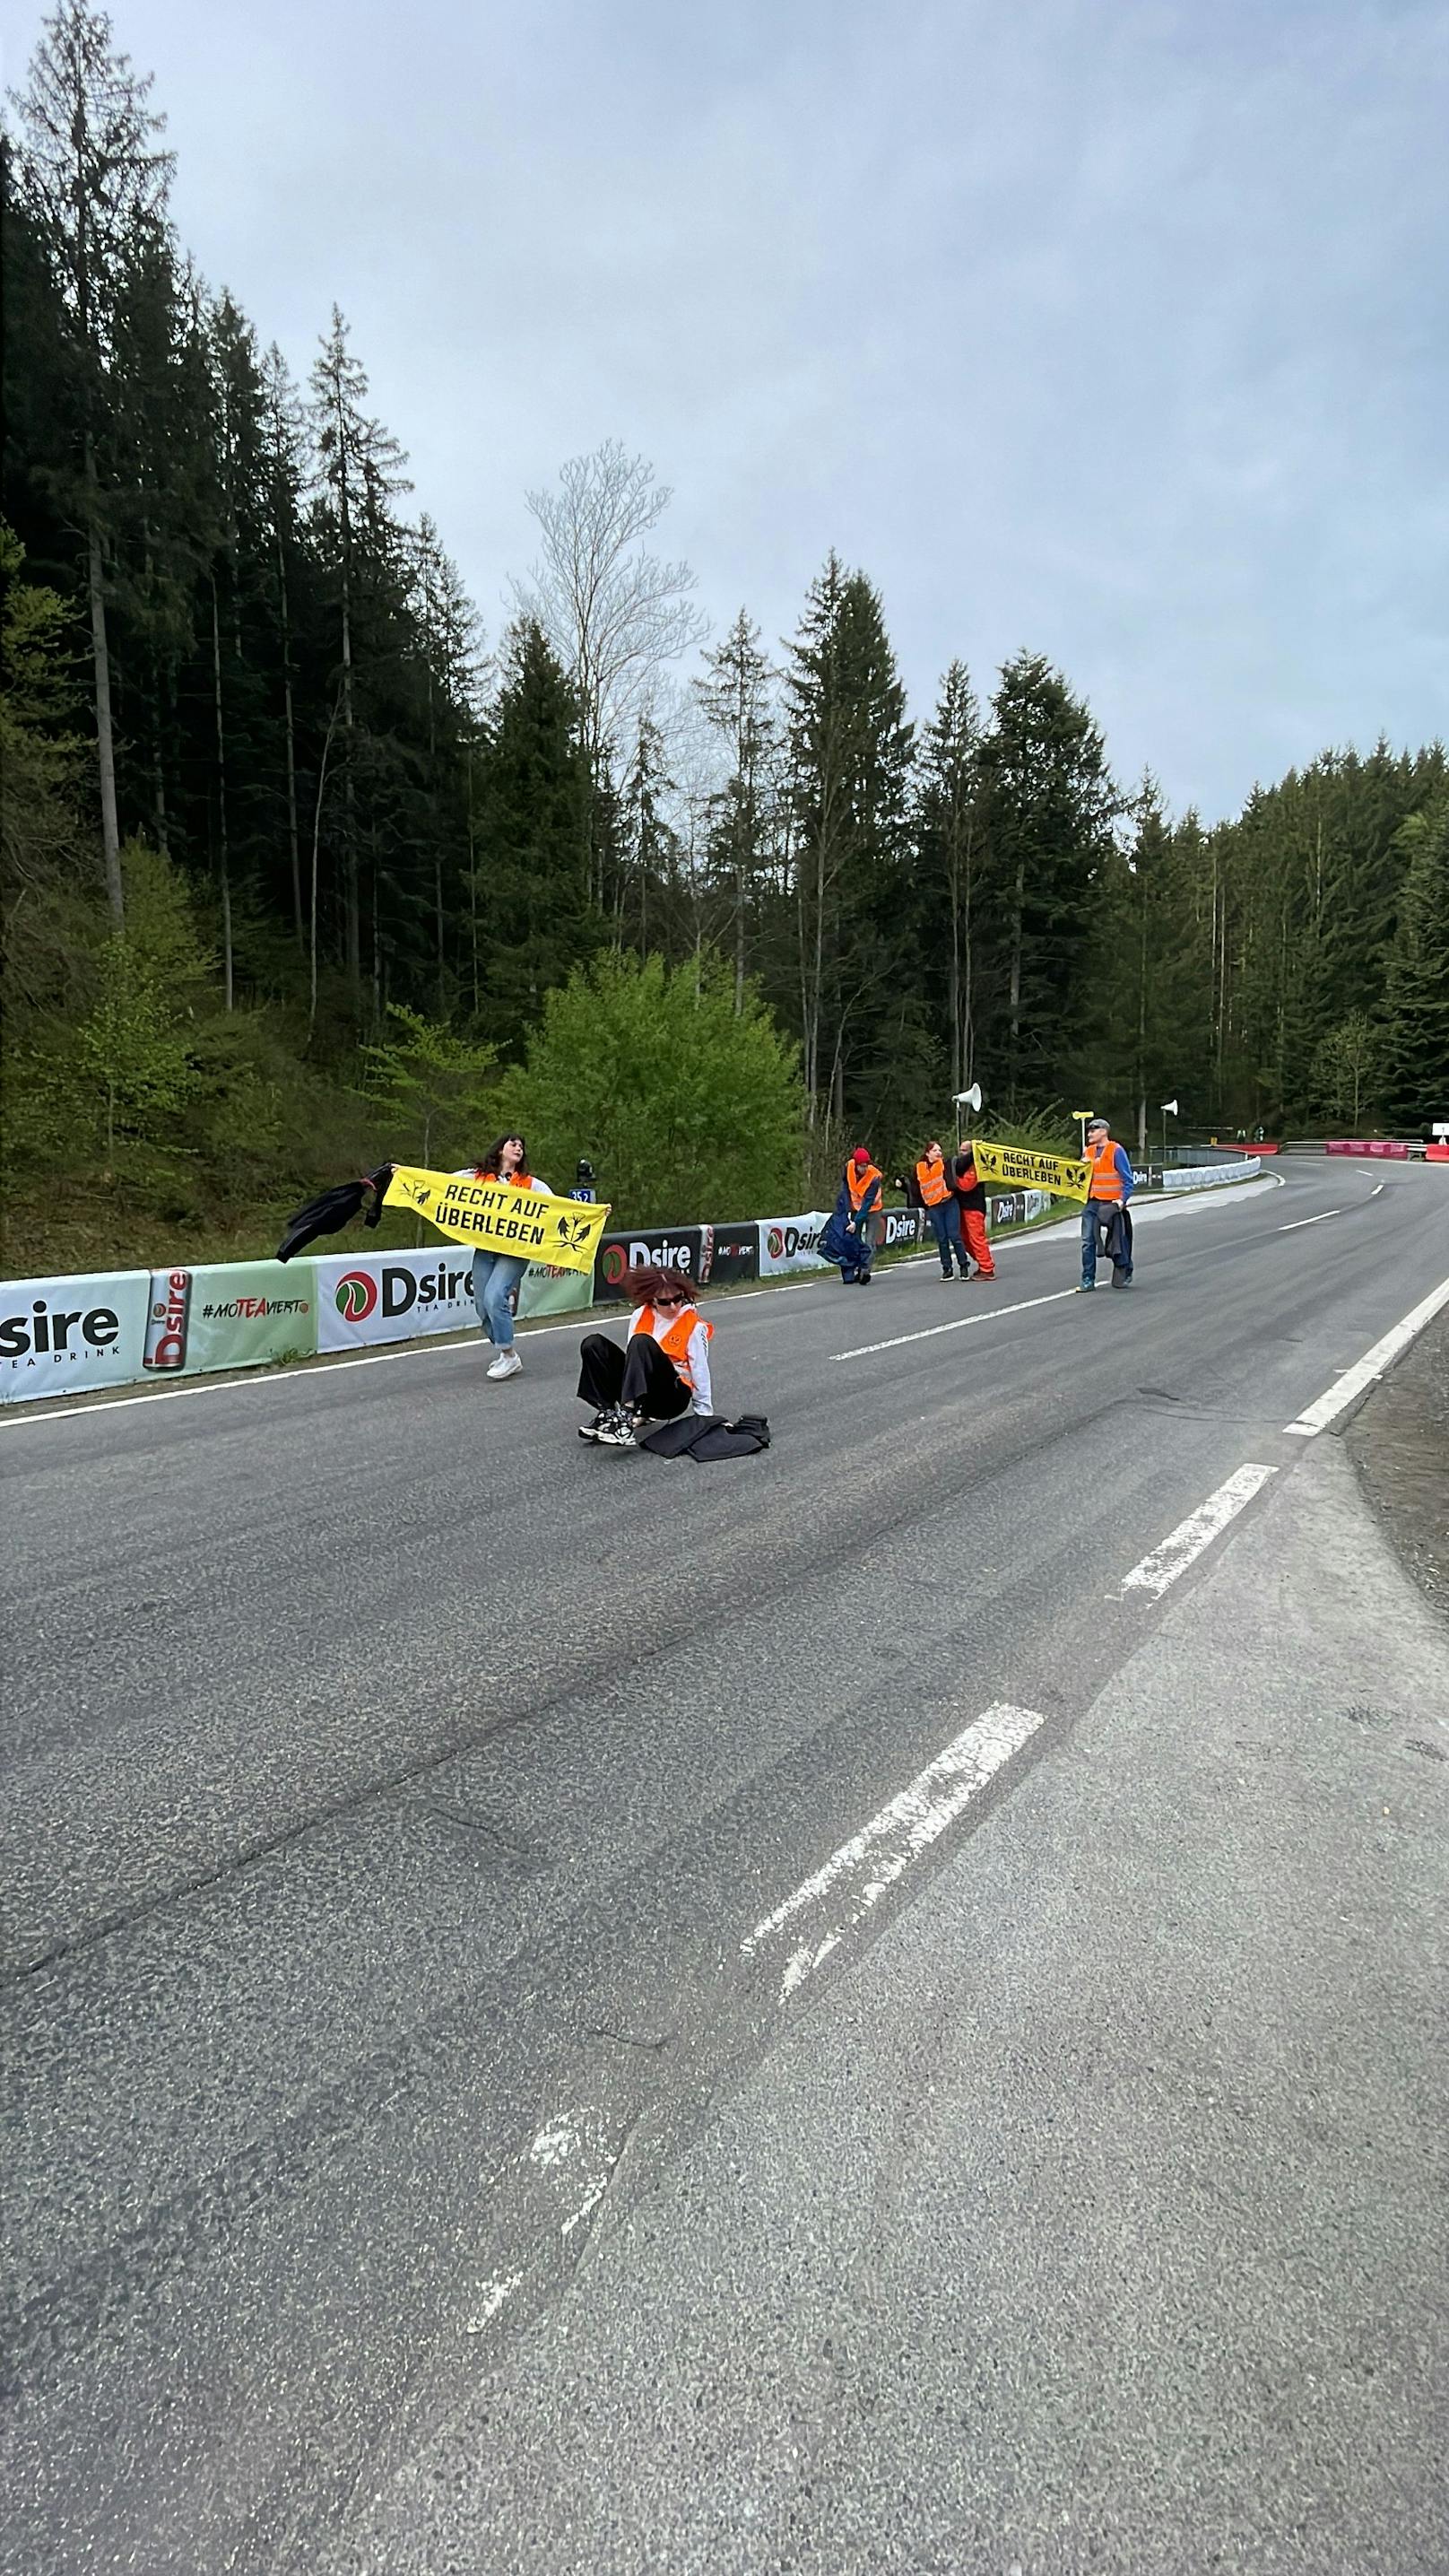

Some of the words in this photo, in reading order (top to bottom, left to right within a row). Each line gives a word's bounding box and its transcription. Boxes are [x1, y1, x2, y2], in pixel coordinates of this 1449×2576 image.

[1002, 1162, 1062, 1186] ÜBERLEBEN
[1003, 1152, 1036, 1166] RECHT
[1039, 1157, 1060, 1171] AUF
[445, 1184, 508, 1210] RECHT
[510, 1197, 550, 1219] AUF
[435, 1202, 545, 1245] ÜBERLEBEN
[886, 1214, 915, 1244] Dsire
[629, 1239, 691, 1272] Dsire
[154, 1272, 187, 1364] Dsire
[417, 1303, 439, 1314] TEA
[447, 1298, 475, 1310] DRIN
[0, 1300, 119, 1357] sire
[54, 1345, 120, 1362] DRINK
